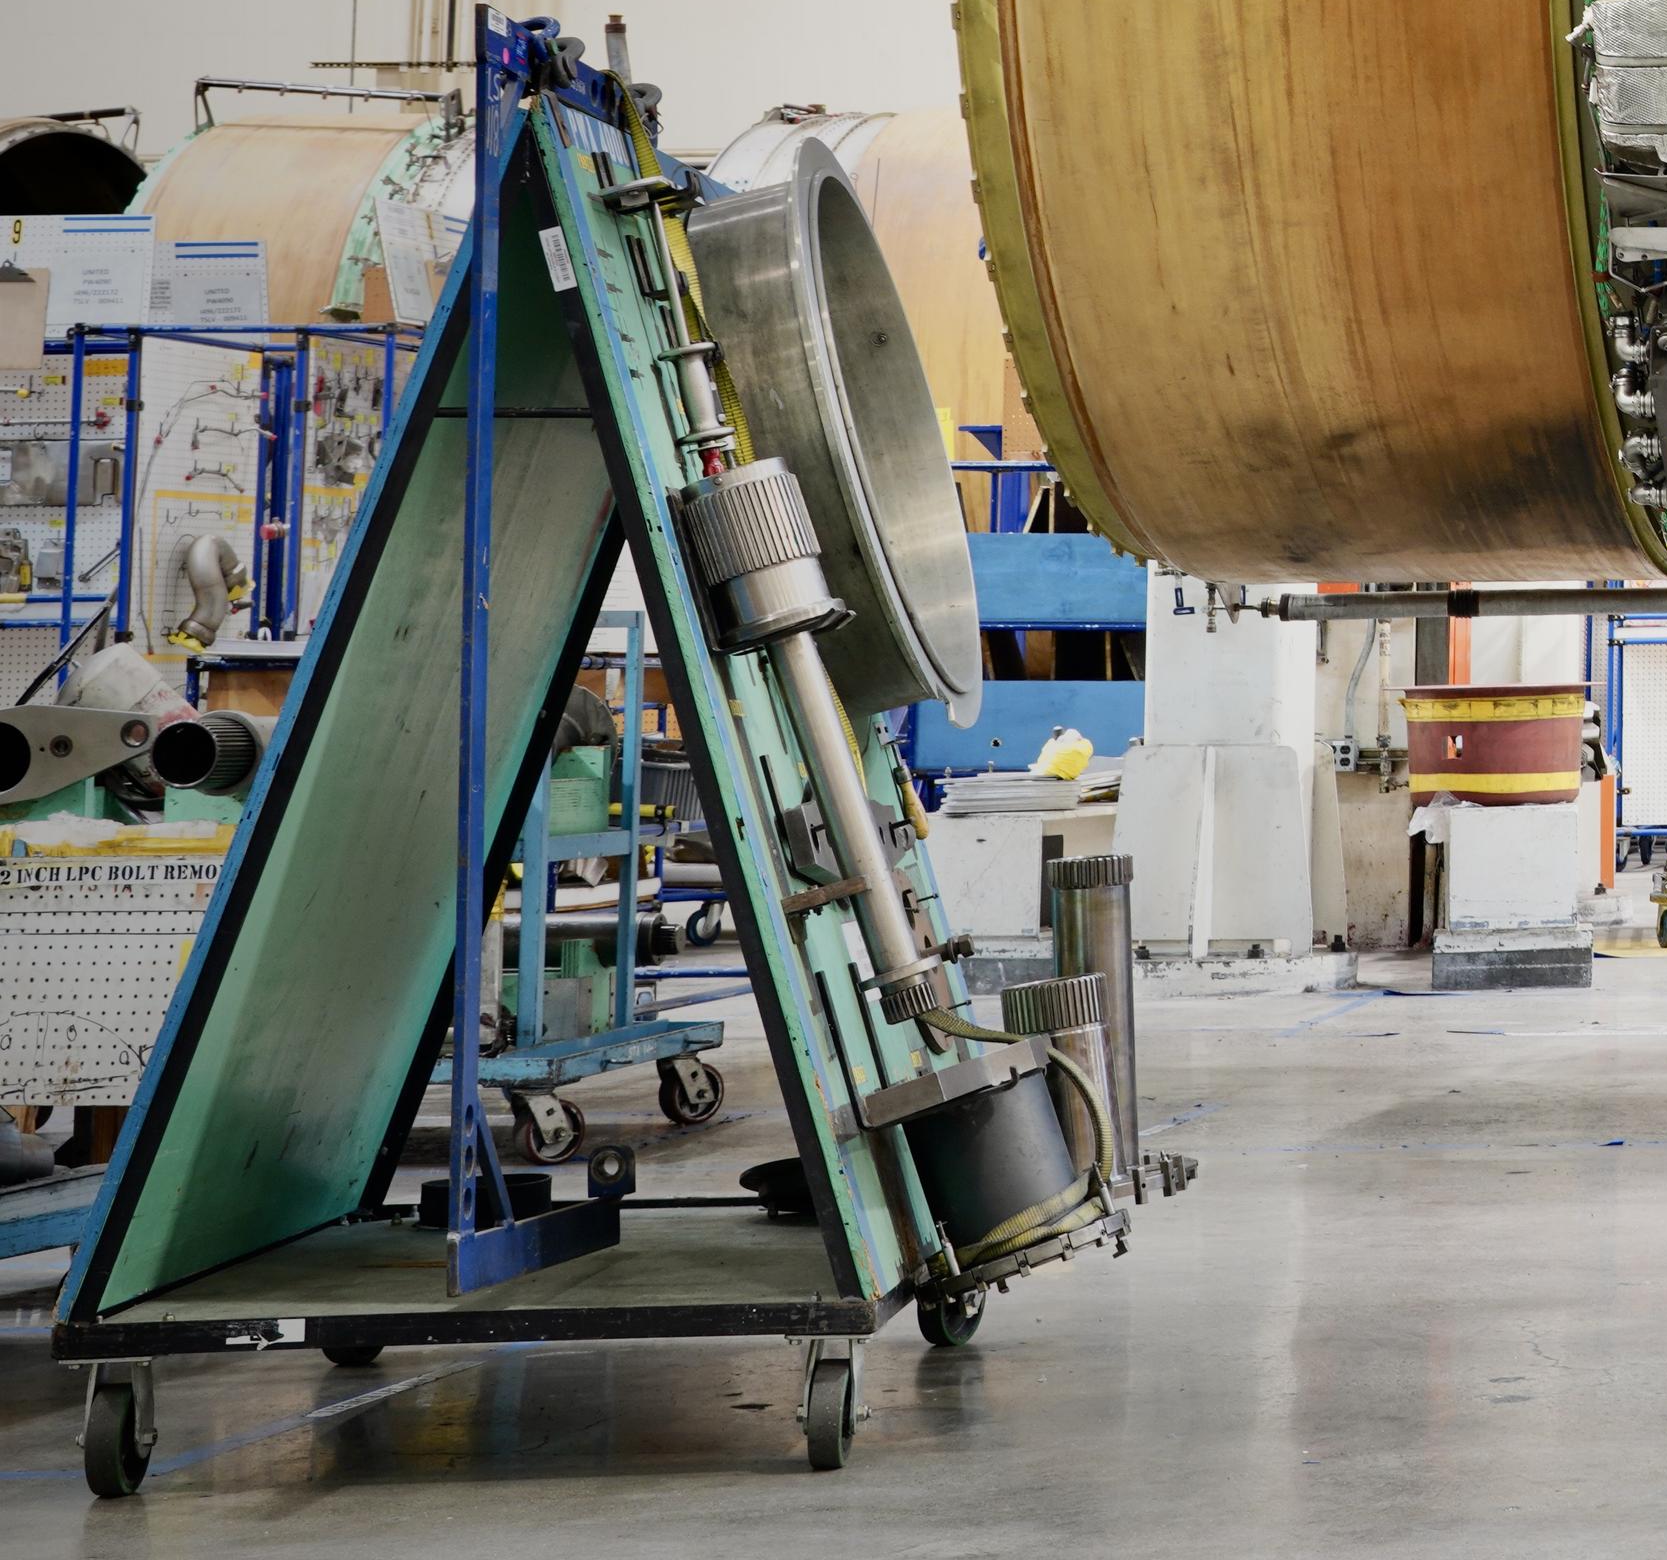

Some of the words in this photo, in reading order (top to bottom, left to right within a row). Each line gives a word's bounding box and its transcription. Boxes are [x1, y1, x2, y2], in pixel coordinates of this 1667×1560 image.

[13, 219, 22, 244] 9
[16, 867, 60, 884] INCH
[66, 865, 102, 882] LPC
[108, 865, 159, 882] BOLT
[164, 863, 224, 881] REMO
